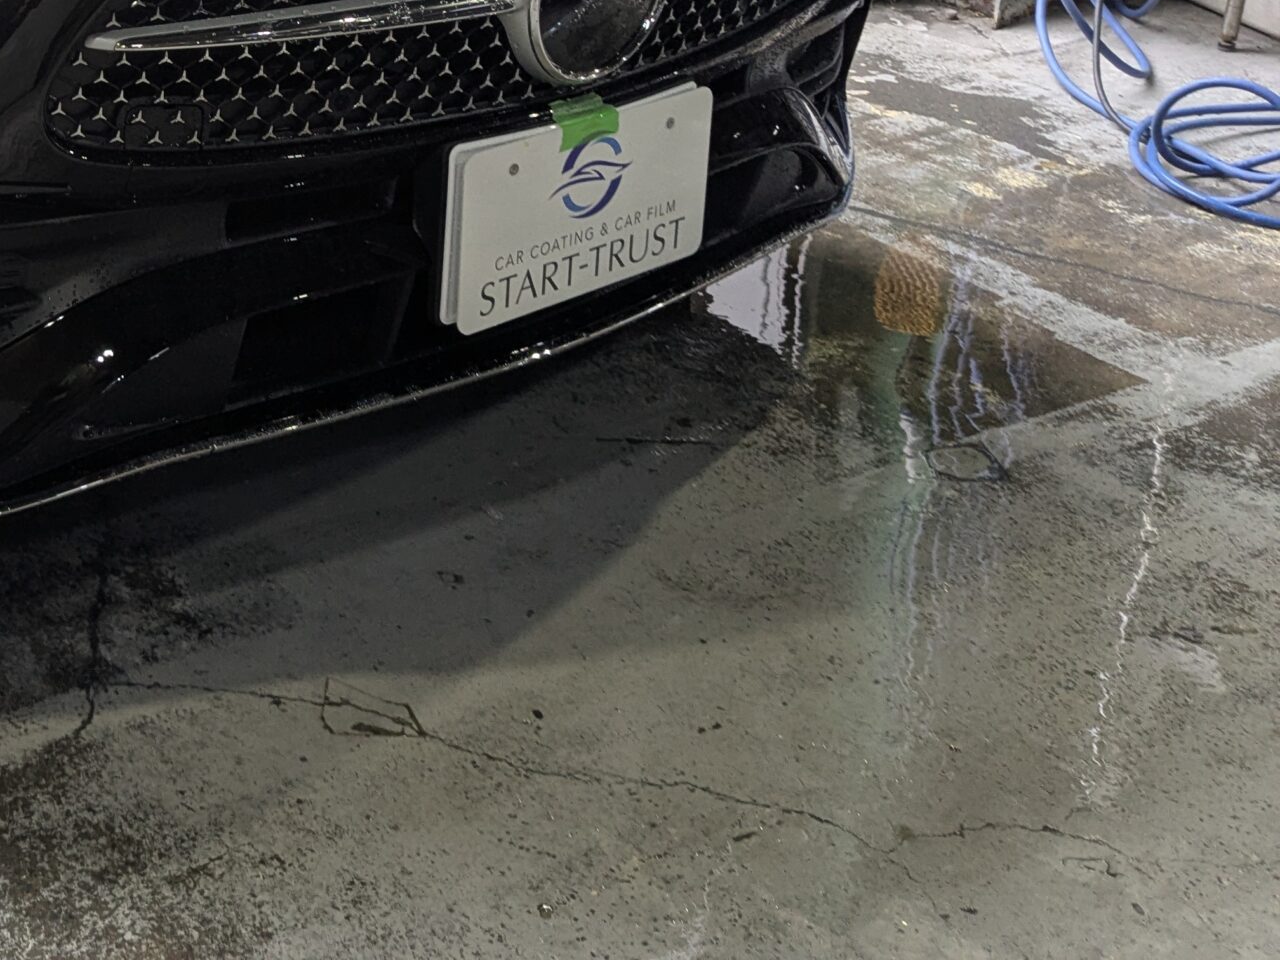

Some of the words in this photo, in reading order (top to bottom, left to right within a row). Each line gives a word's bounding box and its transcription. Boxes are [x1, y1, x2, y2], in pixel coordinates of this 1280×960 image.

[479, 216, 686, 317] START-TRUST
[494, 250, 524, 272] CAR
[529, 223, 594, 260] COATING
[600, 222, 609, 237] &
[614, 210, 642, 232] CAR
[646, 198, 676, 221] FILM
